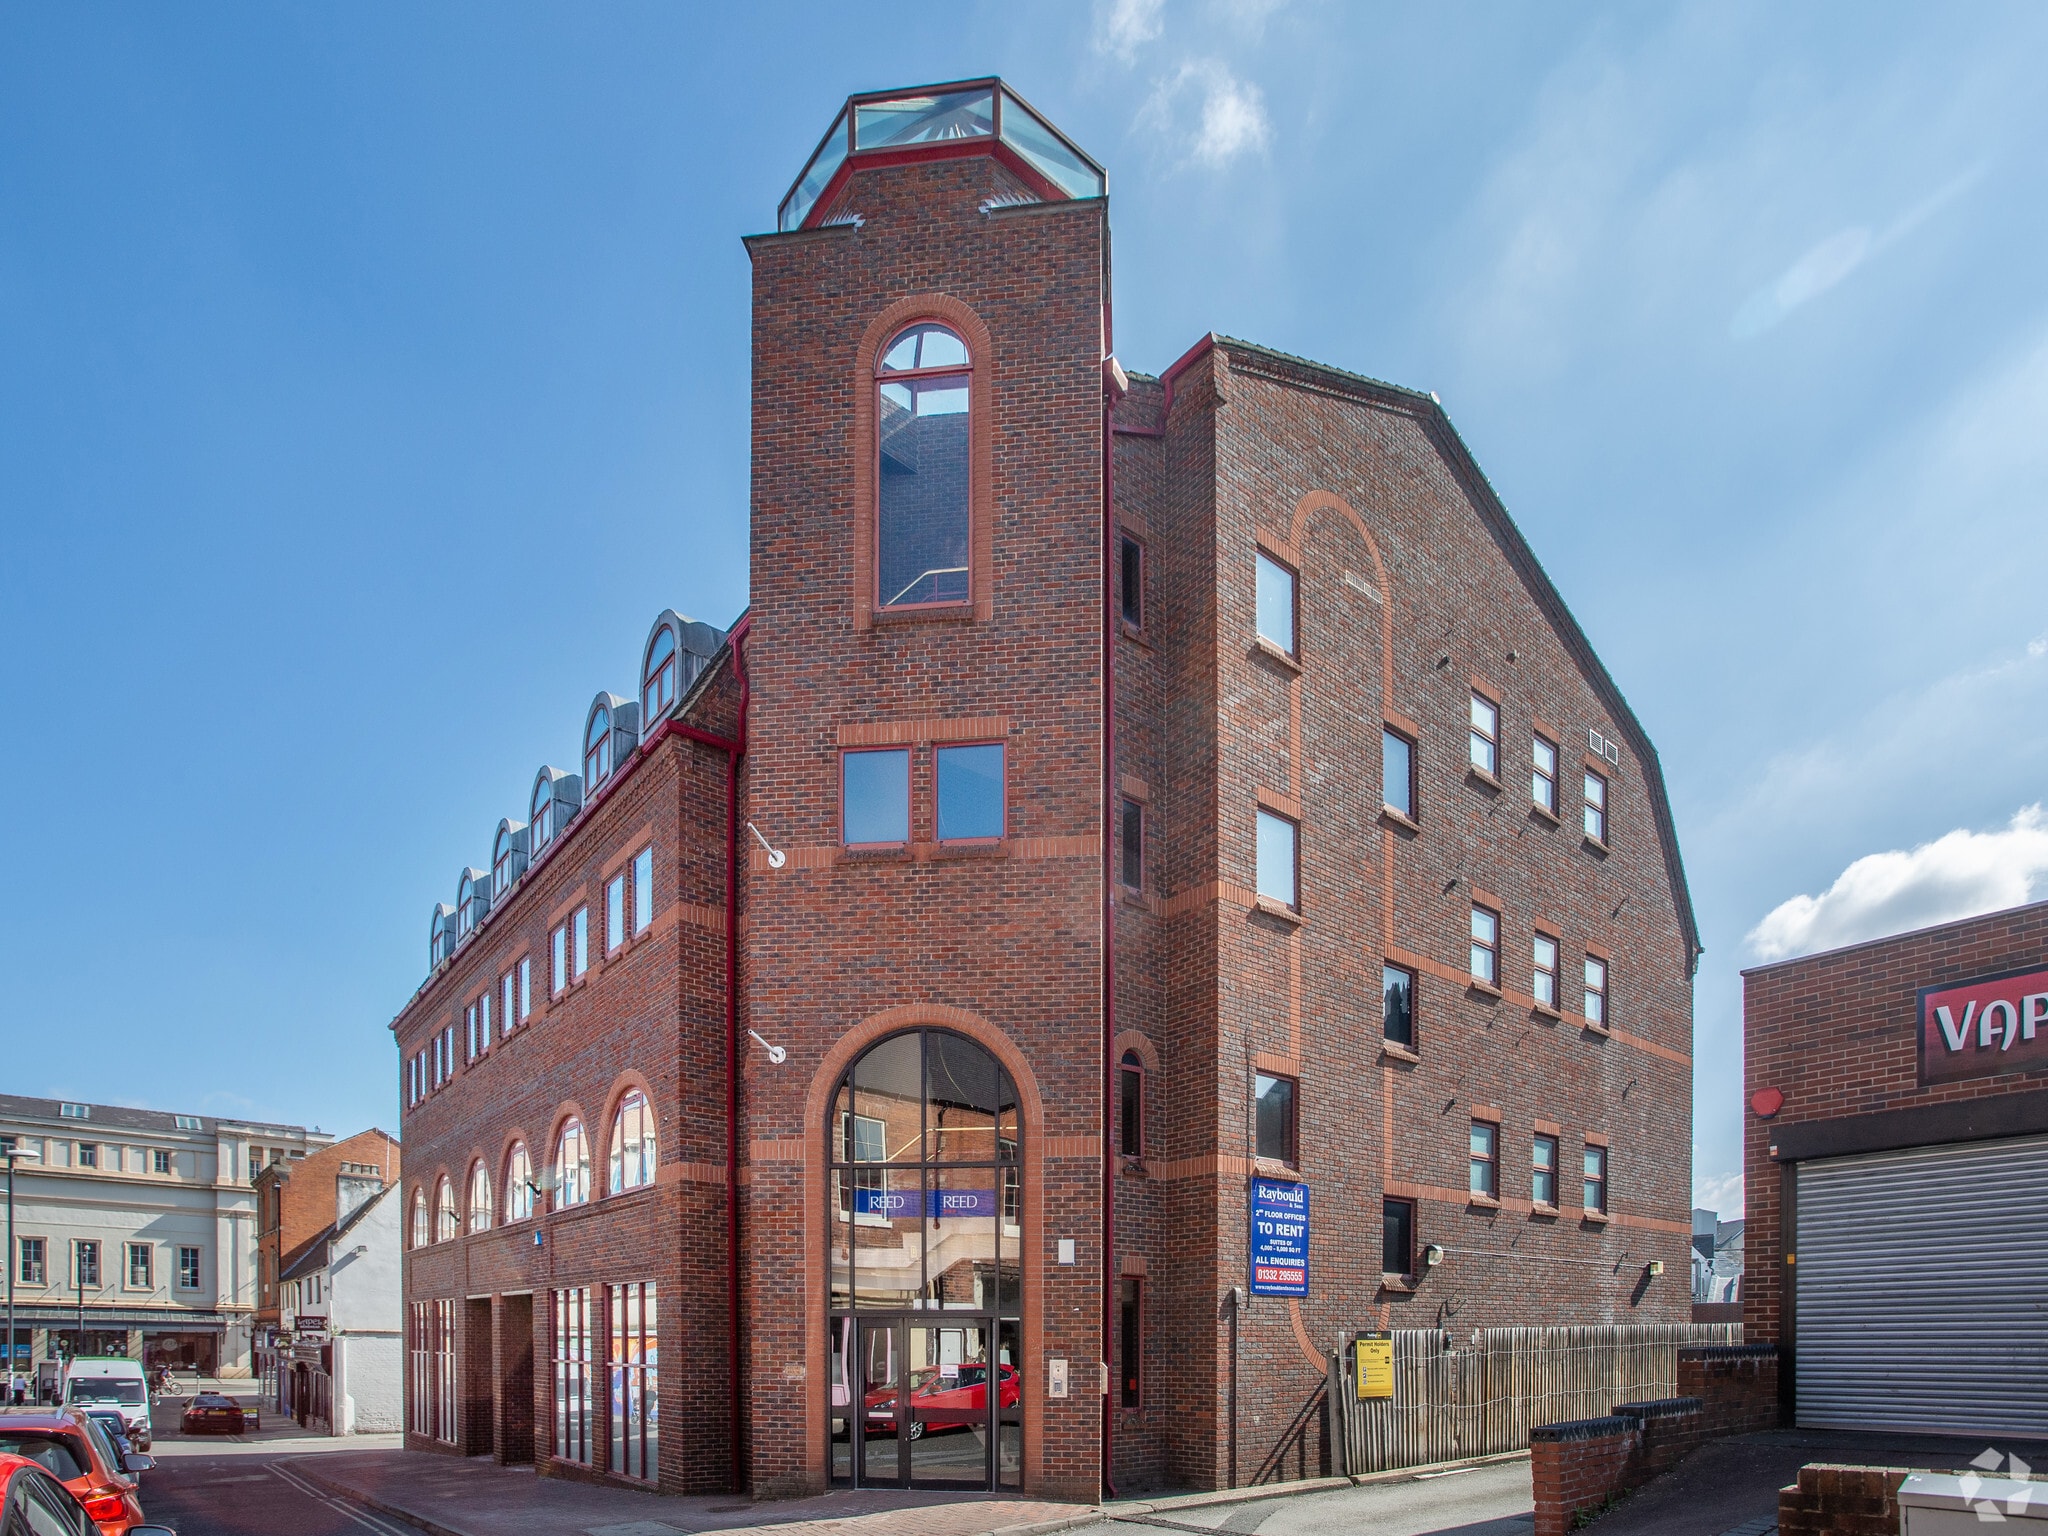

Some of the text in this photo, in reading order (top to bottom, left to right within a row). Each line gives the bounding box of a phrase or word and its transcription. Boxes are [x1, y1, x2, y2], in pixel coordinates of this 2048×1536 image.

[1258, 1185, 1303, 1202] Raybould
[870, 1196, 904, 1208] REED
[943, 1196, 977, 1208] REED
[1284, 1213, 1306, 1221] OFFICES
[1258, 1222, 1304, 1237] TO RENT
[1256, 1256, 1305, 1266] ALL ENQUIRIES
[1258, 1269, 1302, 1282] 01332 295555
